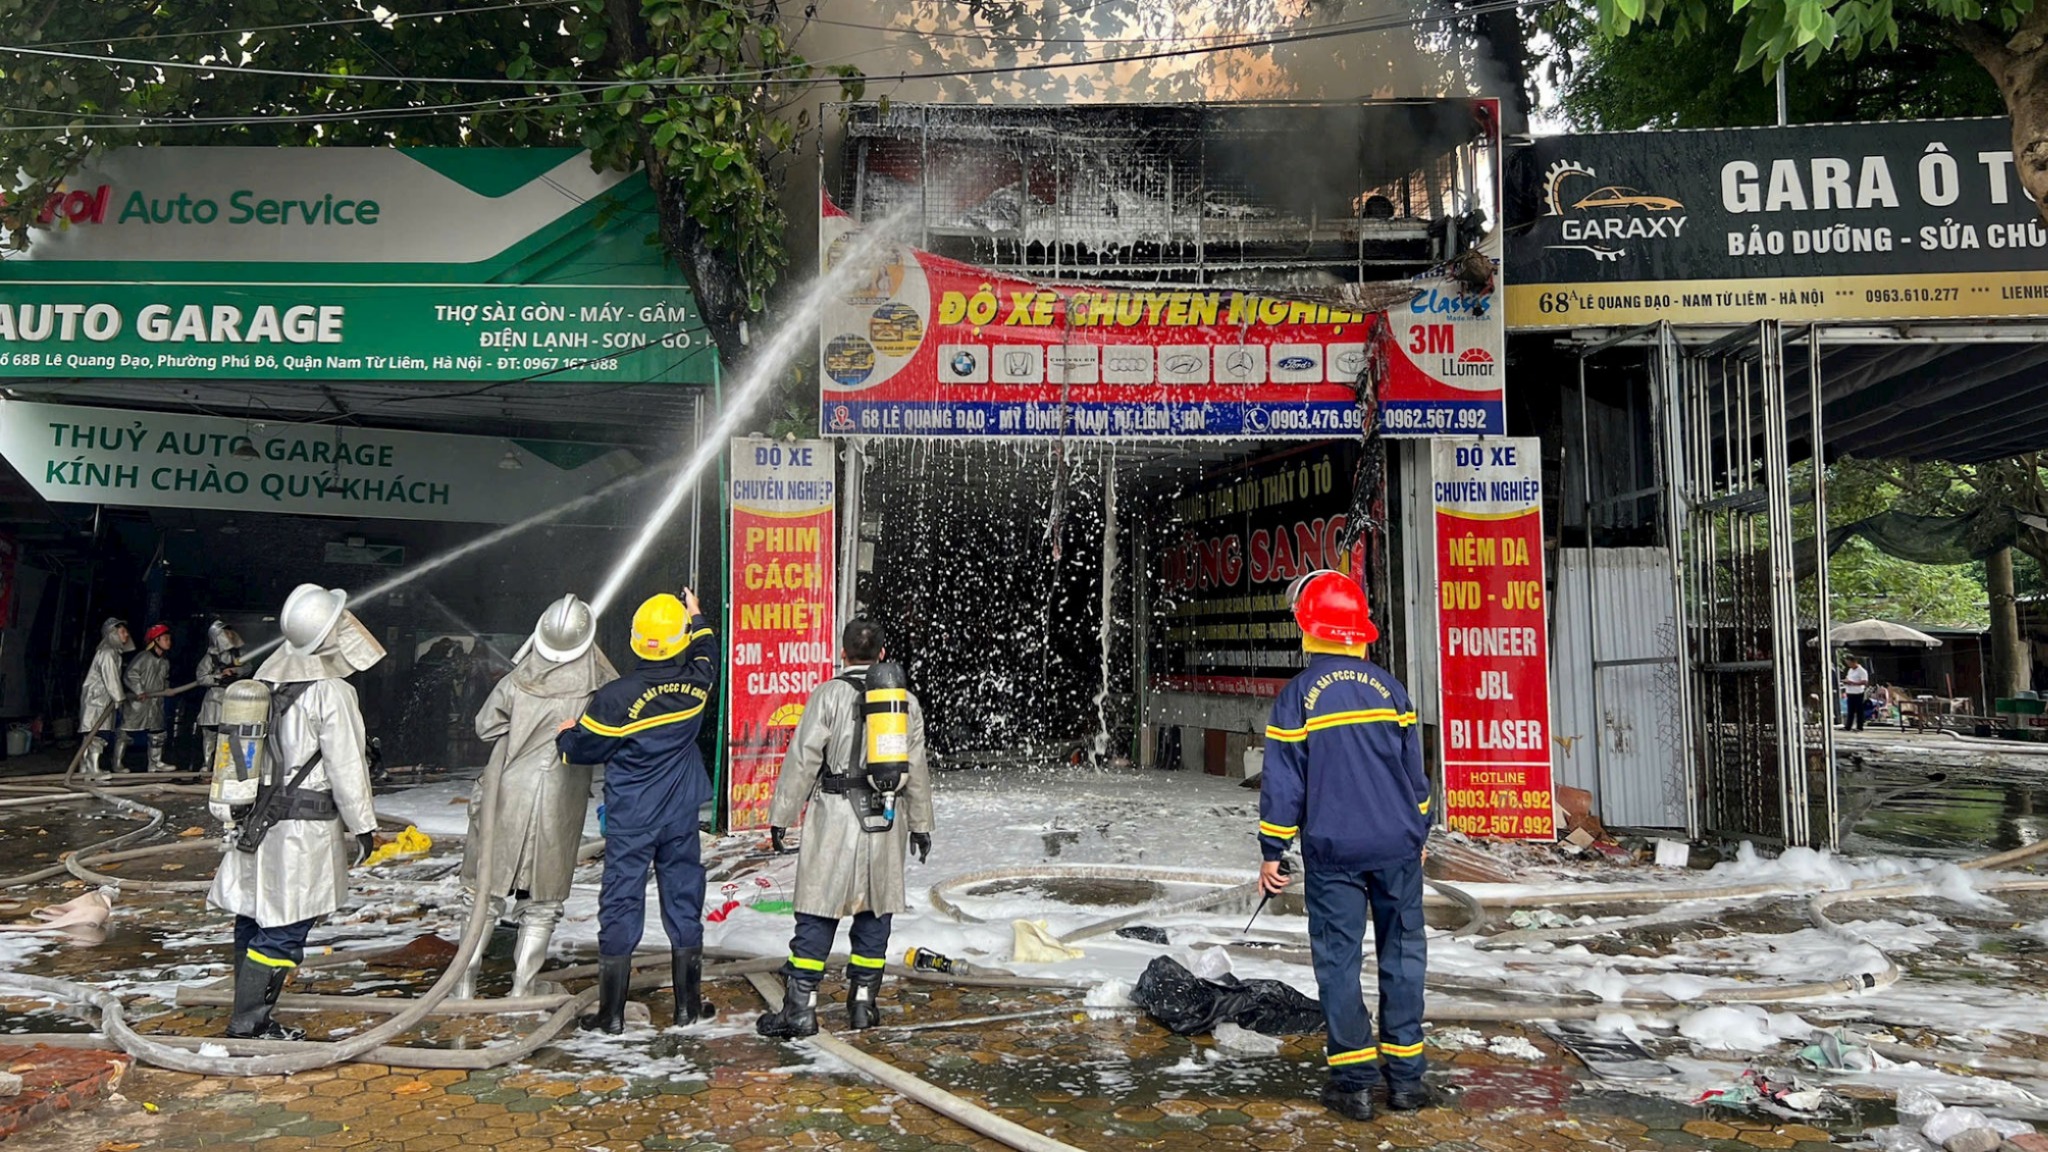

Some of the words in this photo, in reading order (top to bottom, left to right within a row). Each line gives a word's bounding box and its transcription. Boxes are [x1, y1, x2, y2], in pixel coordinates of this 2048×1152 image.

[1721, 156, 1900, 214] GARA
[1918, 141, 1960, 207] Ô
[1978, 151, 2036, 204] T
[119, 190, 218, 225] Auto
[229, 190, 380, 226] Service
[1562, 216, 1688, 241] GARAXY
[1728, 224, 1785, 256] BẢO
[1792, 223, 1893, 255] DƯỠNG
[1920, 217, 1980, 250] SỬA
[939, 282, 998, 336] ĐỘ
[1004, 291, 1057, 326] XE
[1580, 294, 1595, 310] LÊ
[1598, 296, 1641, 310] QUANG
[1645, 294, 1671, 311] ĐẠO
[1682, 294, 1713, 307] NAM
[1716, 290, 1733, 307] TỪ
[1735, 290, 1768, 306] LIÊM
[1780, 289, 1798, 305] HÀ
[1801, 288, 1824, 307] NỘI
[1866, 287, 1960, 303] 0963.610.277
[136, 304, 346, 344] GARAGE
[435, 304, 479, 327] THỢ
[481, 301, 516, 322] SÀI
[521, 301, 567, 322] GÒN
[580, 301, 625, 322] MÁY
[639, 300, 686, 323] GẦM
[480, 327, 527, 352] ĐIỆN
[532, 332, 588, 353] LẠNH
[602, 332, 647, 349] SƠN
[661, 328, 691, 349] GÒ
[1409, 324, 1455, 355] 3M
[13, 353, 40, 366] 68B
[45, 353, 63, 366] Lê
[66, 354, 115, 369] Quang
[120, 354, 153, 370] Đạo,
[157, 353, 217, 371] Phường
[221, 353, 250, 368] Phú
[254, 354, 279, 370] Đô,
[283, 355, 322, 373] Quận
[326, 356, 361, 370] Nam
[366, 355, 387, 371] Từ
[389, 355, 429, 373] Liêm,
[433, 355, 454, 370] Hà
[456, 355, 482, 373] Nội
[497, 356, 521, 371] ĐT:
[523, 356, 559, 371] 0967
[1442, 357, 1494, 377] LLumar
[861, 409, 880, 429] 68
[883, 405, 900, 430] LÊ
[904, 409, 952, 431] QUANG
[956, 408, 985, 434] ĐẠO
[1075, 410, 1109, 431] NAM
[1385, 408, 1487, 429] 0962.567.992
[48, 421, 148, 453] THUỶ
[264, 437, 394, 468] GARAGE
[755, 444, 782, 470] ĐỘ
[788, 448, 813, 467] XE
[1456, 443, 1484, 471] ĐỘ
[1491, 447, 1517, 467] XE
[45, 456, 139, 489] KÍNH
[150, 464, 249, 495] CHÀO
[261, 470, 334, 501] QUÝ
[341, 474, 449, 505] KHÁCH
[733, 477, 784, 500] CHUYÊN
[787, 477, 833, 505] NGHIỆP
[1237, 474, 1260, 517] NỘI
[1261, 460, 1296, 508] THẤT
[1299, 460, 1309, 500] Ô
[1312, 453, 1333, 496] TÔ
[1435, 478, 1487, 503] CHUYÊN
[1491, 477, 1540, 506] NGHIỆP
[745, 526, 821, 553] PHIM
[1449, 532, 1496, 573] NỆM
[1502, 537, 1530, 566] DA
[744, 558, 822, 590] CÁCH
[1442, 581, 1482, 610] DVD
[1502, 581, 1541, 610] JVC
[741, 598, 824, 635] NHIỆT
[735, 642, 762, 666] 3M
[779, 641, 831, 665] VKOOL
[1448, 627, 1538, 657] PIONEER
[657, 682, 680, 695] PCCC
[747, 671, 819, 695] CLASSIC
[1332, 669, 1356, 682] PCCC
[1475, 670, 1514, 700] JBL
[1450, 719, 1471, 750] BI
[1477, 719, 1543, 750] LASER
[1470, 772, 1526, 784] HOTLINE
[1447, 789, 1551, 809] 0903.476.992
[1448, 815, 1552, 835] 0962.567.992
